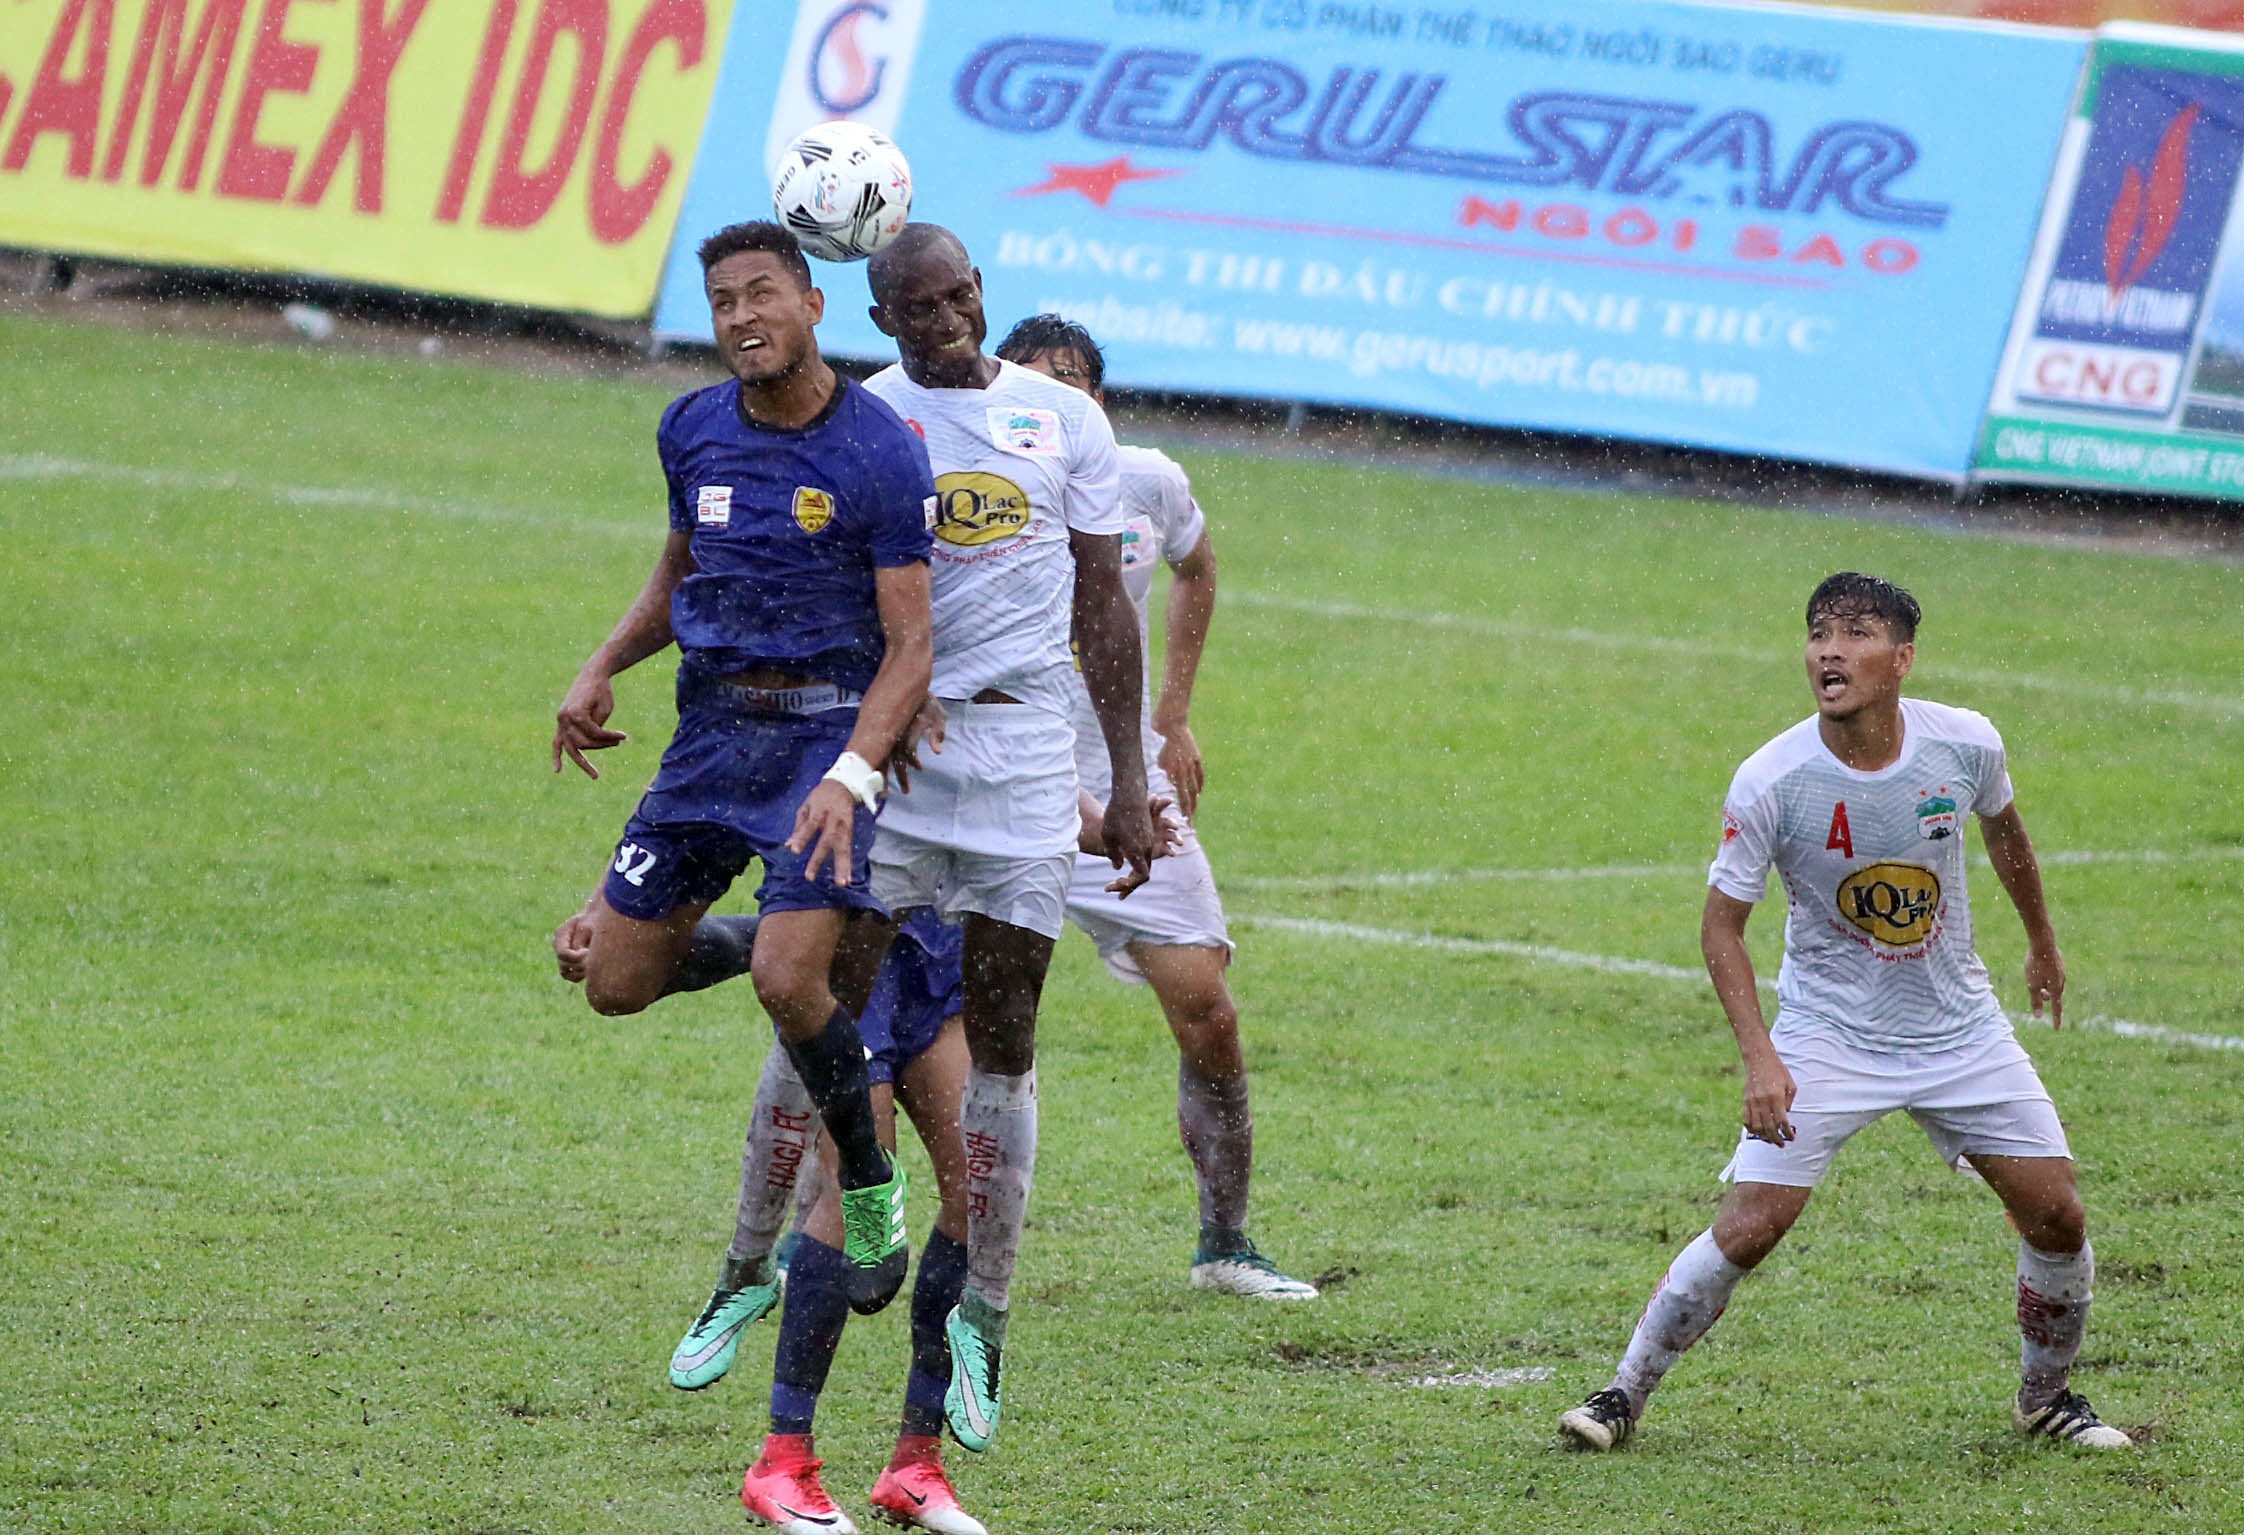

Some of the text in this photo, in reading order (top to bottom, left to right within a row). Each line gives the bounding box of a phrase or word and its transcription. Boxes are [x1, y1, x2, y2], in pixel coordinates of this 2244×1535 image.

[0, 0, 709, 244] AMEX IDC
[953, 35, 1951, 232] GERU STAR
[1178, 249, 1285, 293] THI
[1733, 223, 1919, 274] SAO
[1234, 318, 1761, 409] www.gerusport.com.vn
[2035, 351, 2164, 404] CNG
[986, 513, 1020, 526] Pro
[615, 842, 657, 887] 32
[766, 1105, 811, 1190] HAGL FC
[966, 1131, 999, 1218] HAGL FC
